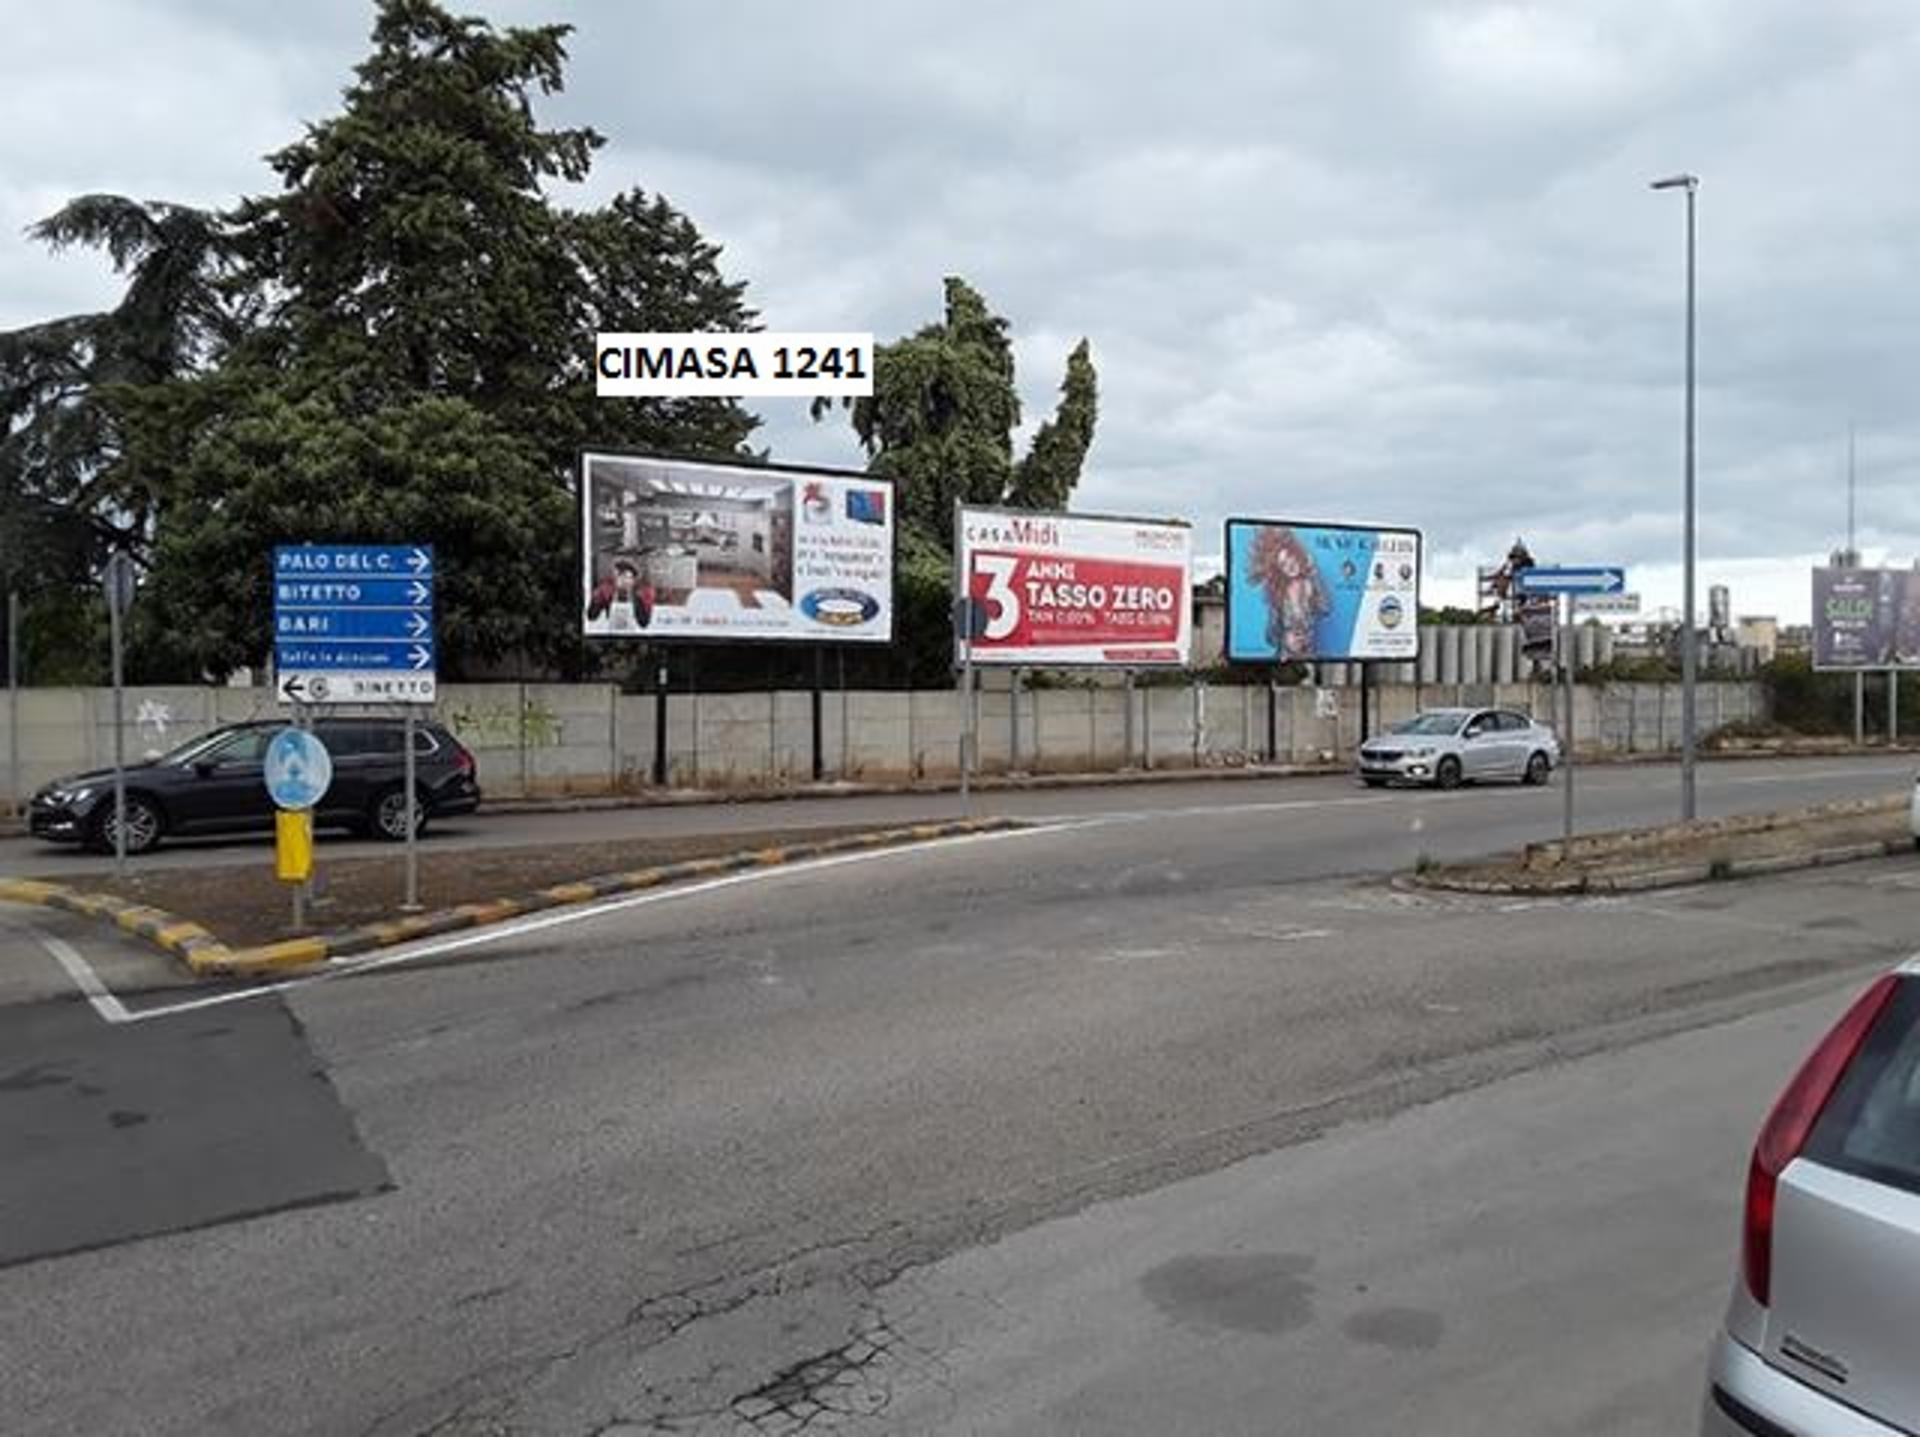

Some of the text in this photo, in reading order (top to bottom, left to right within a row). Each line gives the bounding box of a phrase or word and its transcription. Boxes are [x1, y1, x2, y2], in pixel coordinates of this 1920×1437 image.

[279, 553, 329, 570] PALO
[335, 553, 372, 570] DEL
[1026, 560, 1076, 580] ANNI
[278, 584, 362, 601] BITETTO
[974, 555, 1020, 640] 3
[1025, 582, 1174, 611] TASSO ZERO
[278, 616, 330, 632] BARI
